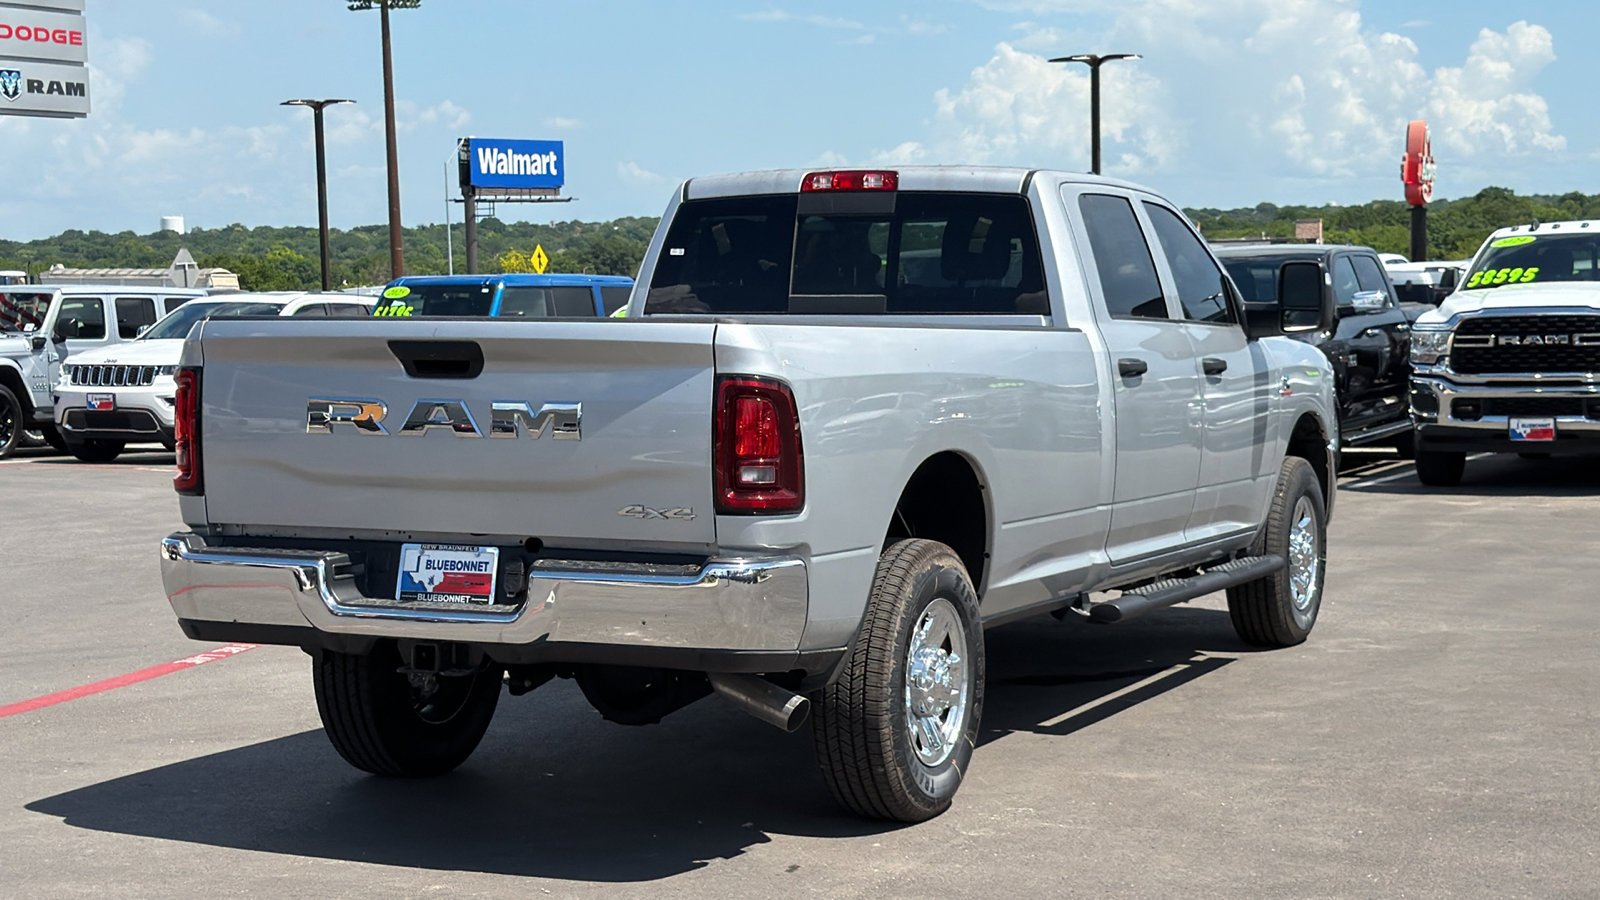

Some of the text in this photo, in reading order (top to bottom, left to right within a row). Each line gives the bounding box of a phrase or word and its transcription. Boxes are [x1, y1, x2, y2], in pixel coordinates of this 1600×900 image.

[0, 24, 82, 46] DODGE
[27, 79, 85, 97] RAM
[478, 148, 557, 176] Walmart
[1467, 267, 1539, 288] 58595
[1498, 334, 1569, 345] RAM
[306, 396, 582, 441] RAM
[425, 559, 490, 573] BLUEBONNET
[417, 593, 471, 603] BLUEBONNET
